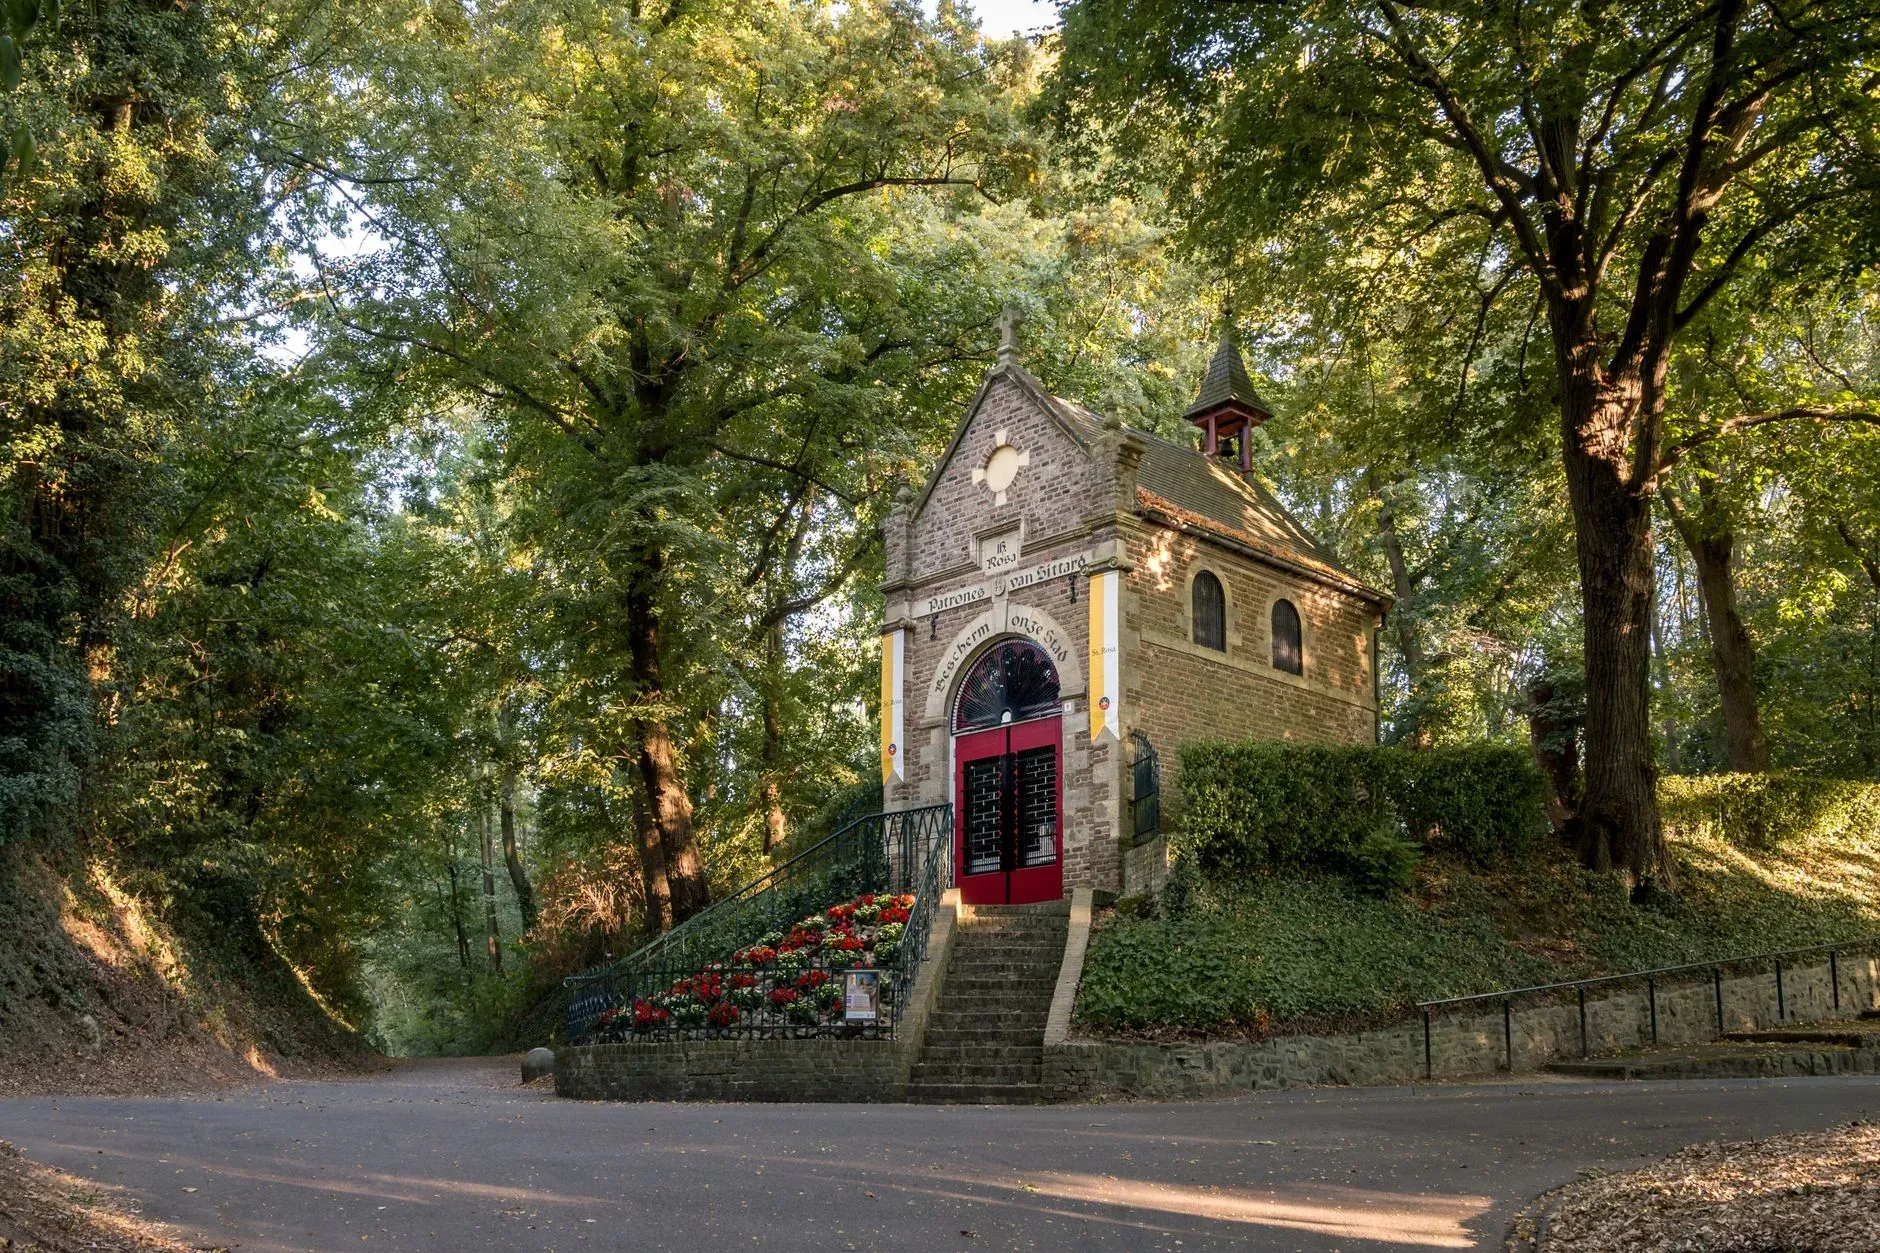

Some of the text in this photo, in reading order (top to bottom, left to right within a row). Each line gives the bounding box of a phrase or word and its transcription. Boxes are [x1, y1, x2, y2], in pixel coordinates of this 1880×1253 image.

[986, 553, 1016, 569] Rosa
[928, 554, 1086, 613] Patrones van Sittard
[935, 615, 1068, 693] Bescherm onze Stad
[1101, 646, 1116, 654] Rosa
